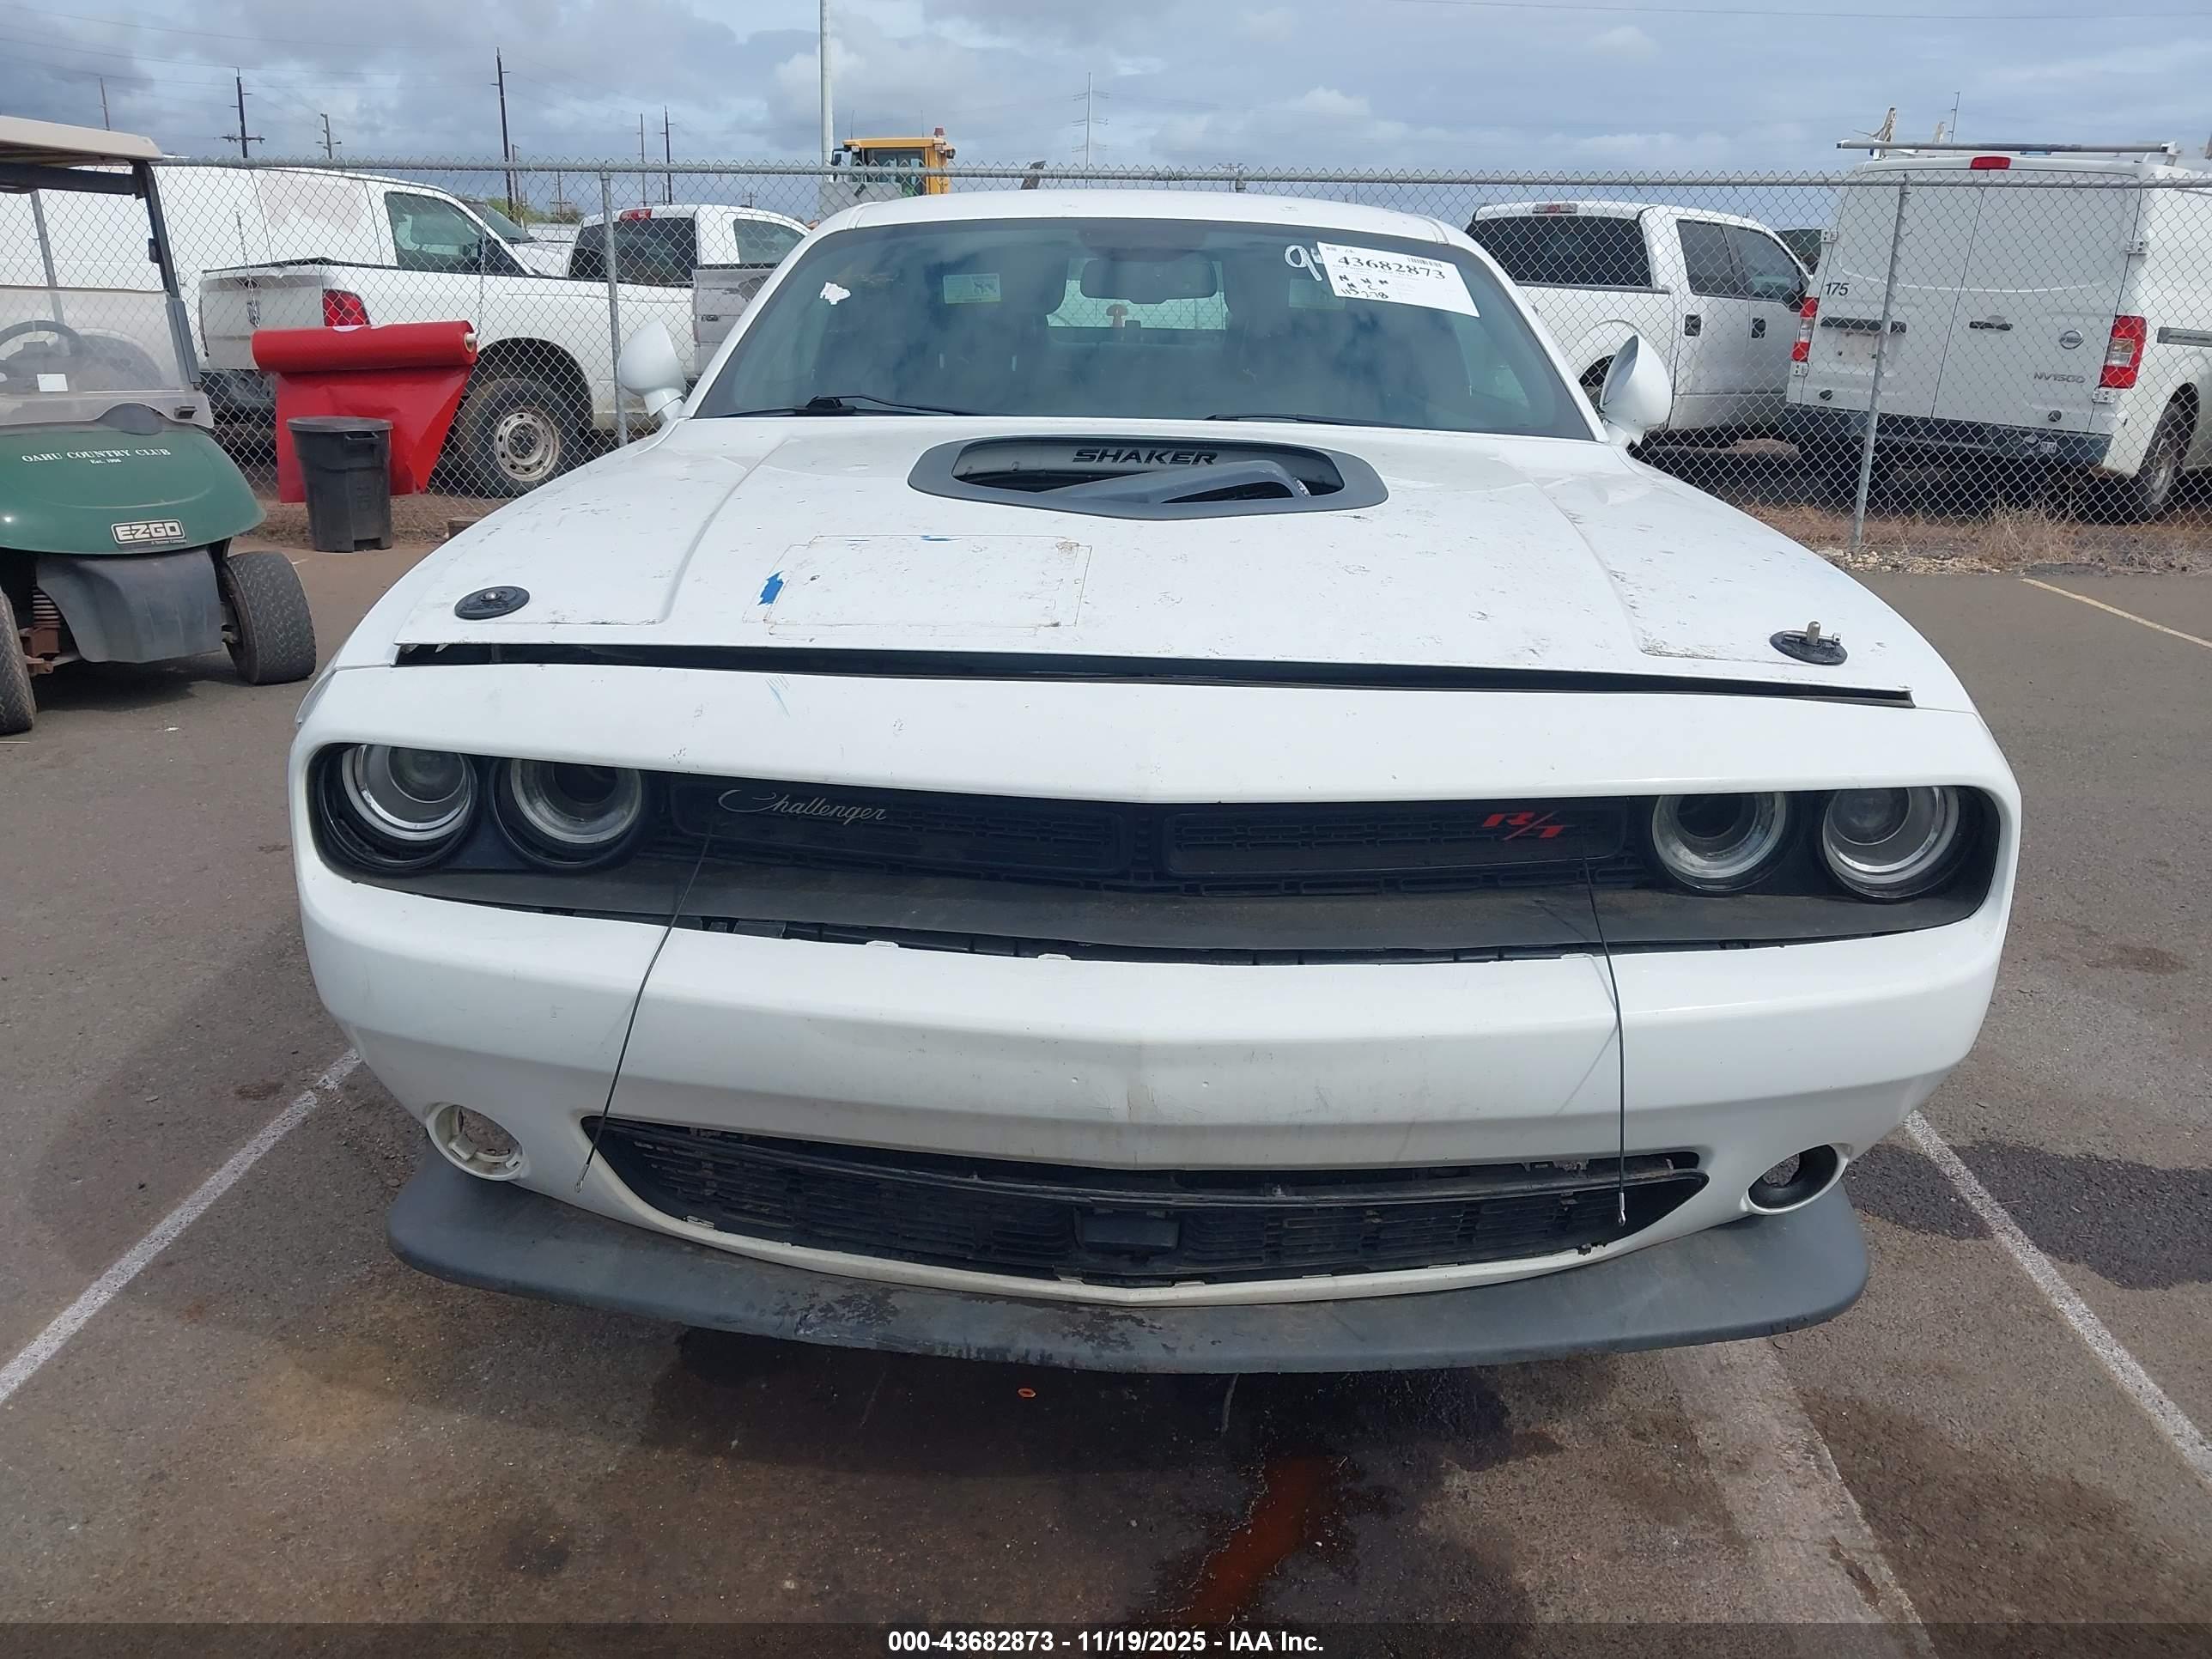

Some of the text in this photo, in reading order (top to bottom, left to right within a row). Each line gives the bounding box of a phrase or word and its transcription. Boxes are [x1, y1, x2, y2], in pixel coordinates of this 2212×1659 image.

[1338, 256, 1445, 280] 43682873
[1826, 283, 1850, 296] 175
[21, 448, 172, 462] OAHU COUNTRY CLUB
[1073, 448, 1218, 465] SHAKER
[718, 789, 887, 825] Challenger
